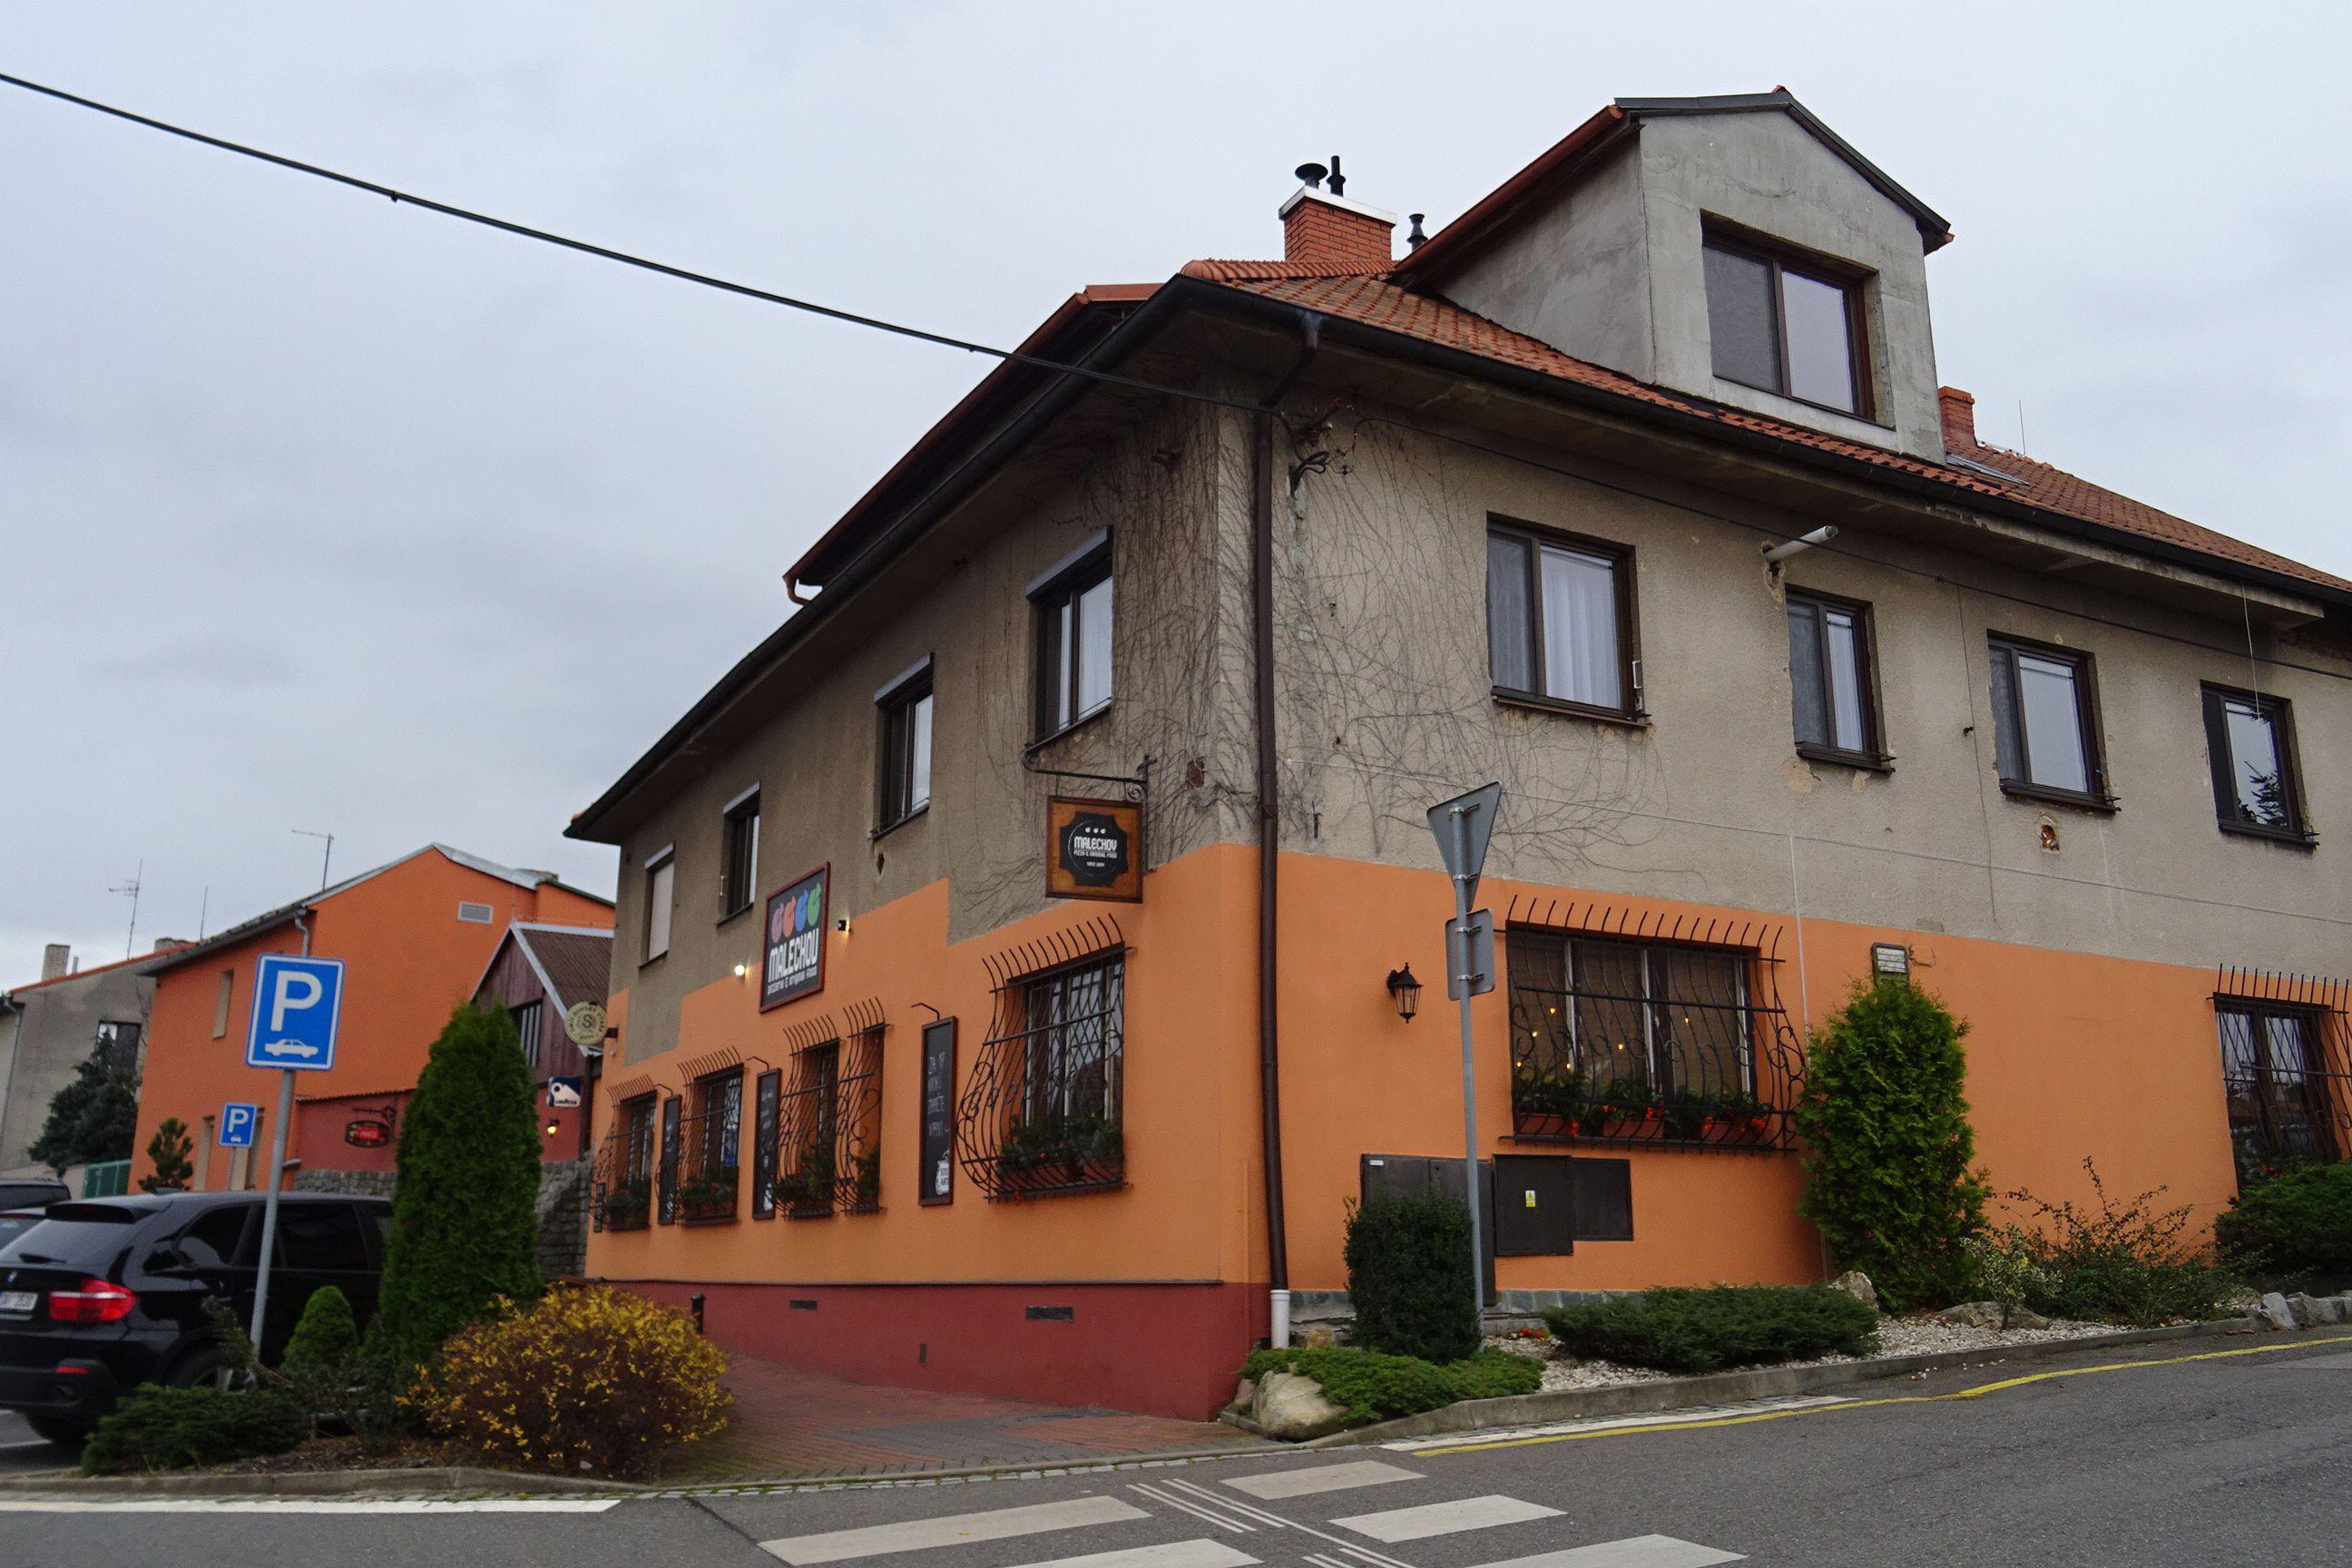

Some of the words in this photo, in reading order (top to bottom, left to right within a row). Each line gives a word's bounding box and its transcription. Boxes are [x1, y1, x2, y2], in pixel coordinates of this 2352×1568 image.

[1073, 836, 1117, 851] MALECHOV
[769, 927, 819, 984] MALECHOV
[271, 970, 322, 1031] P
[228, 1108, 249, 1133] P
